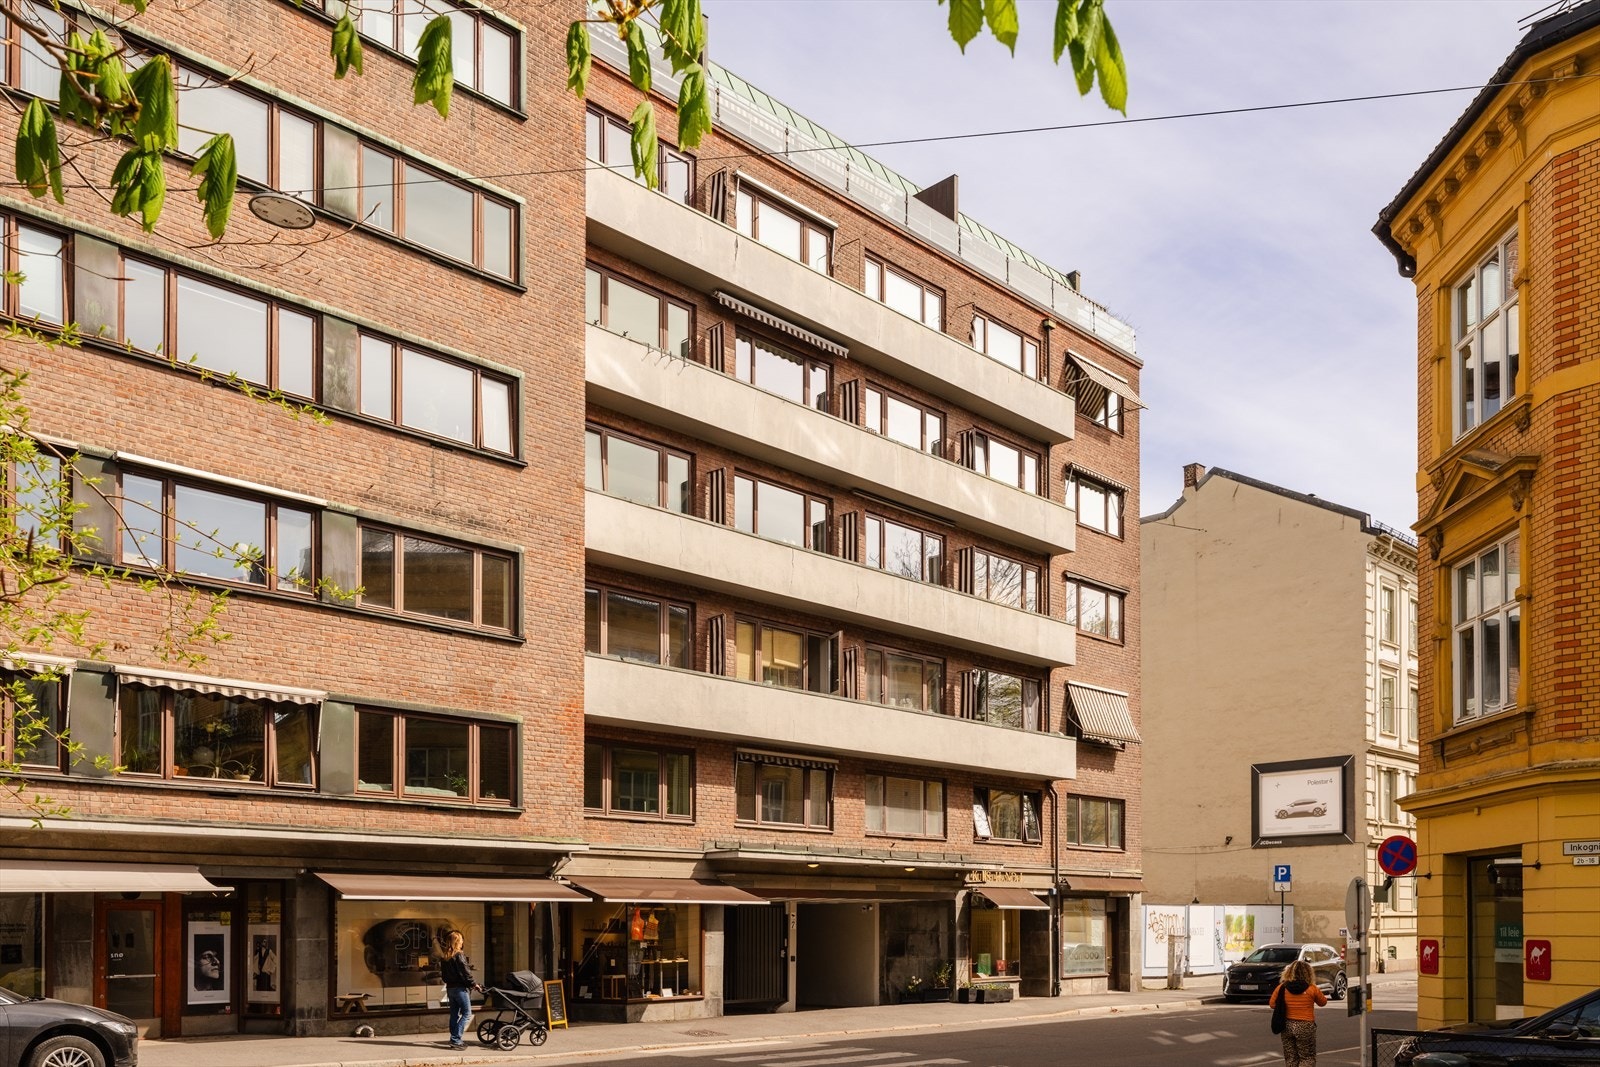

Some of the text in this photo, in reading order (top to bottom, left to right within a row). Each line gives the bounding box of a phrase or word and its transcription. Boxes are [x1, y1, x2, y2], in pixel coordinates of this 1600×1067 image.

[1278, 867, 1287, 880] P
[1499, 926, 1520, 937] Til leie
